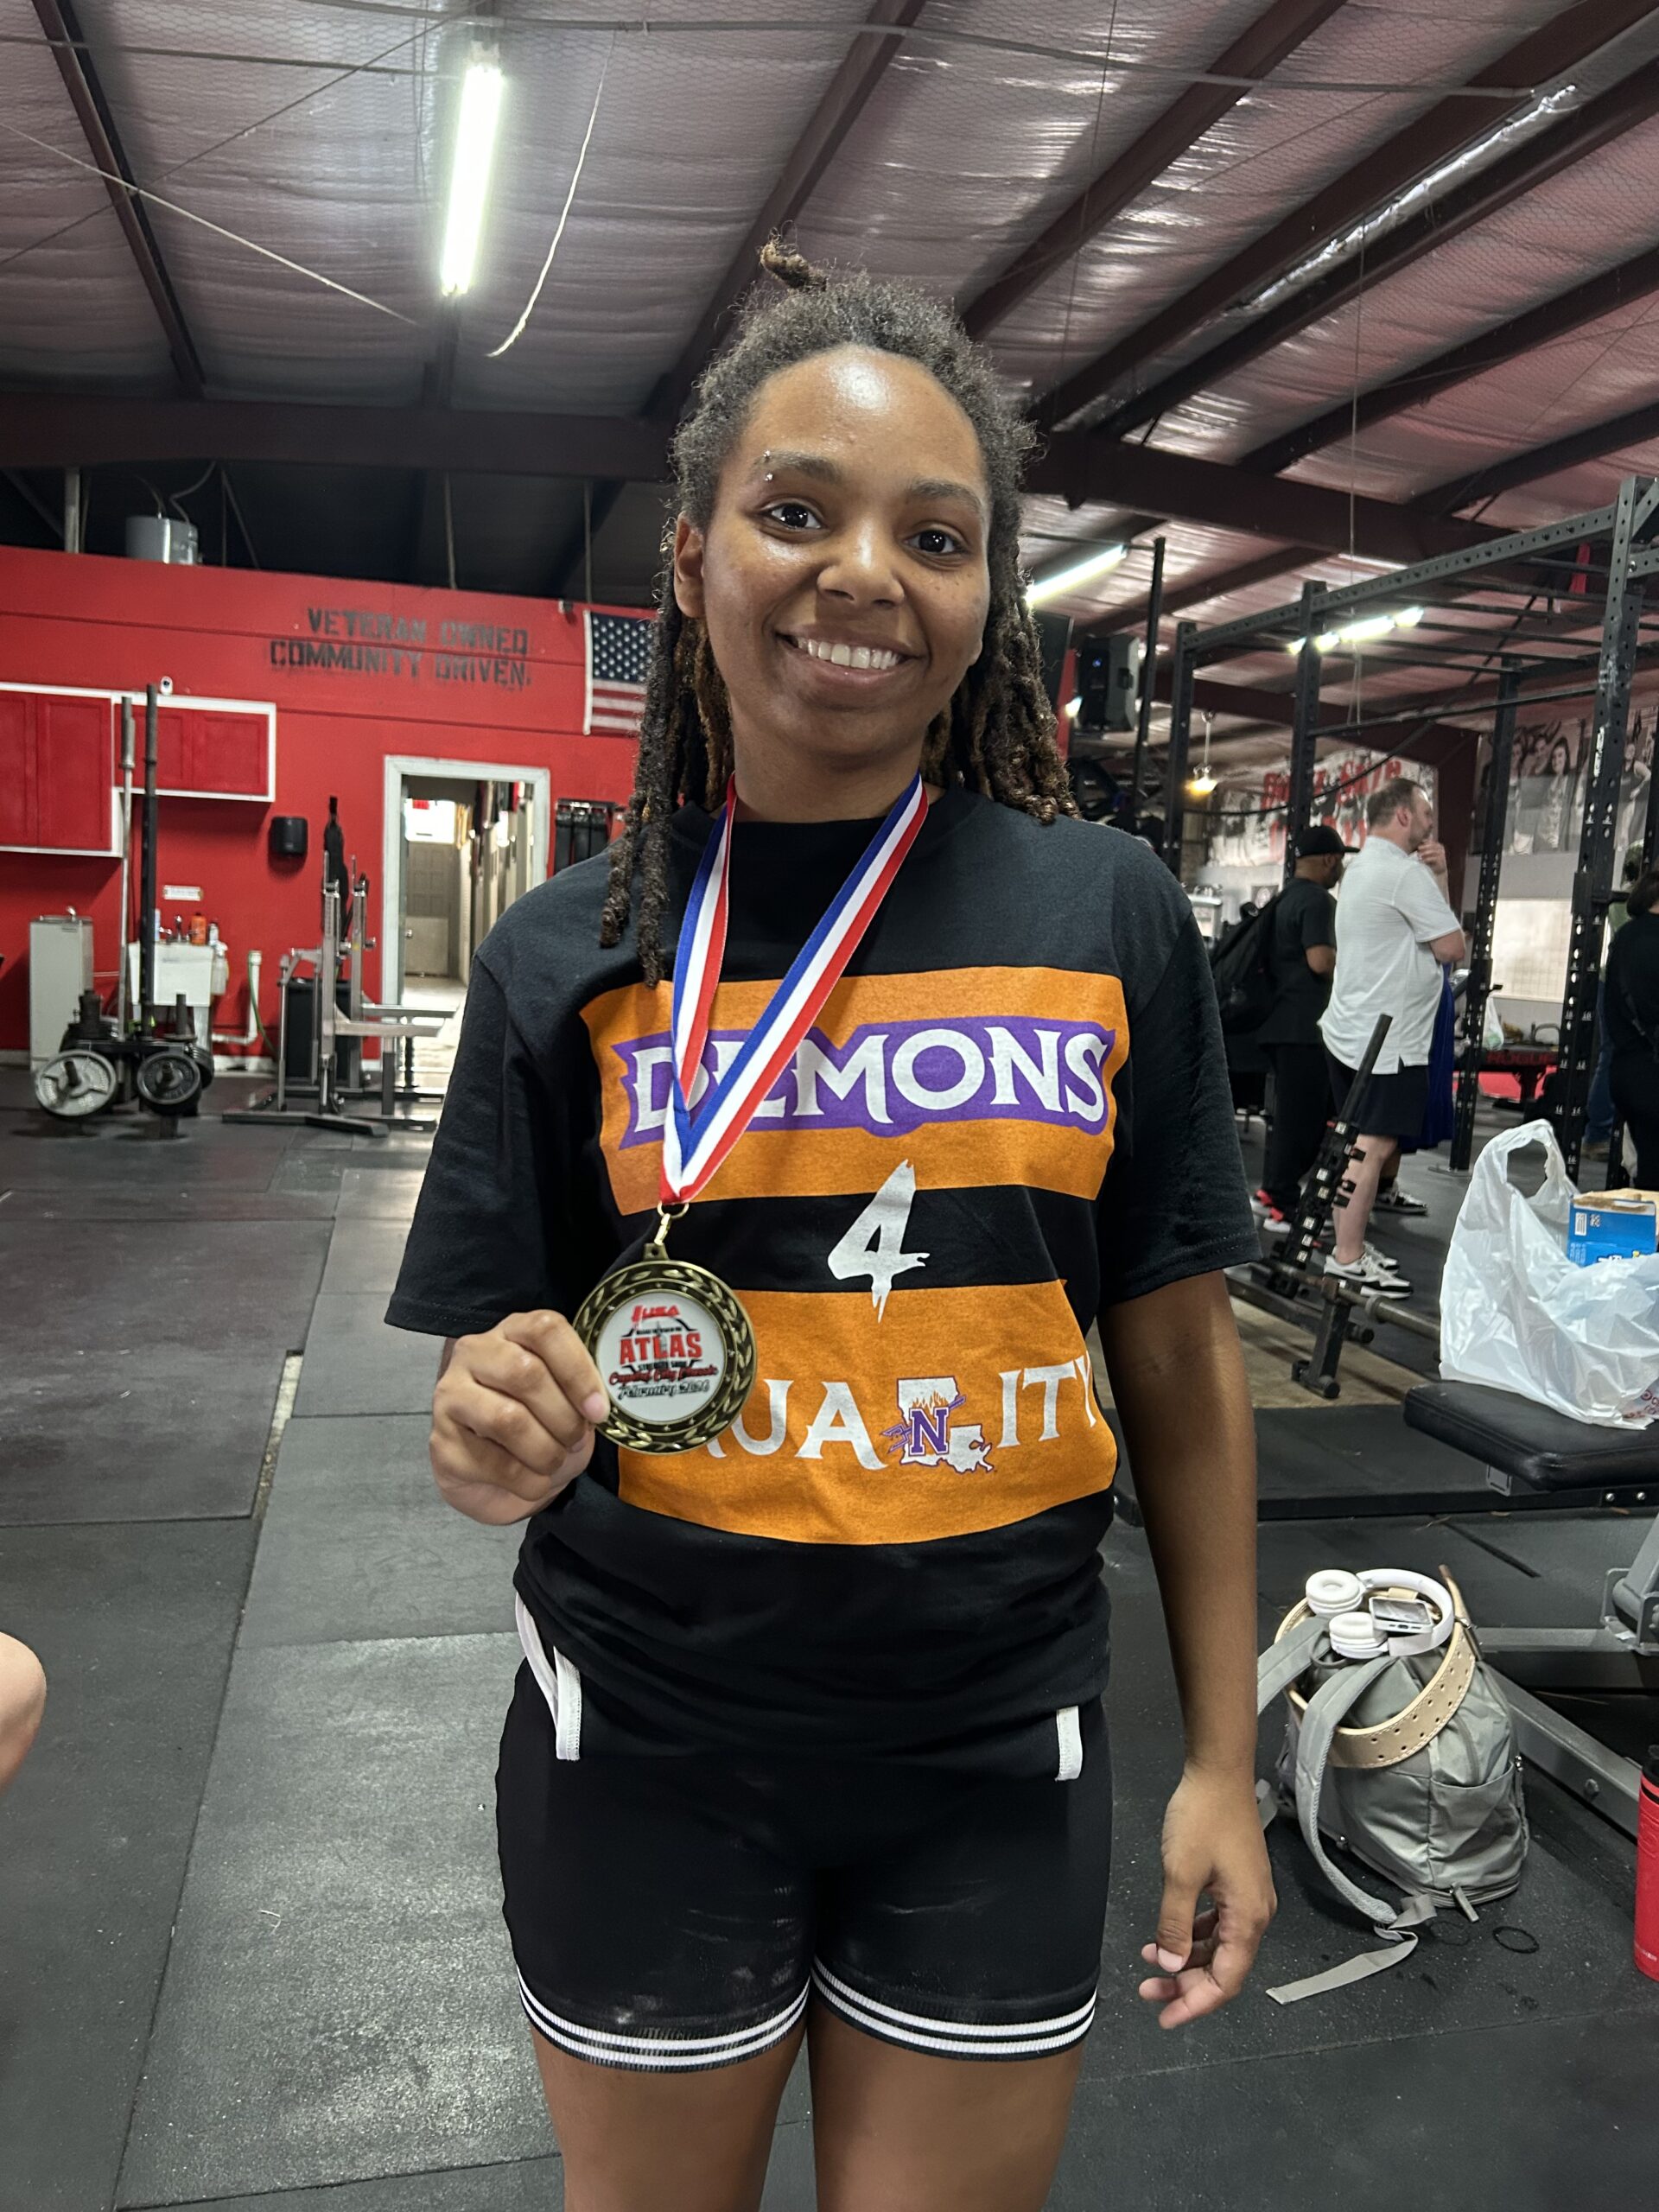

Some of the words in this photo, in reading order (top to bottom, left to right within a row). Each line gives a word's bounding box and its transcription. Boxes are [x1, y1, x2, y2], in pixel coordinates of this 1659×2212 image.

[308, 607, 427, 643] VETERAN
[439, 620, 528, 655] OWNED
[270, 639, 423, 677] COMMUNITY
[827, 1159, 931, 1324] 4
[620, 1332, 702, 1365] ATLAS
